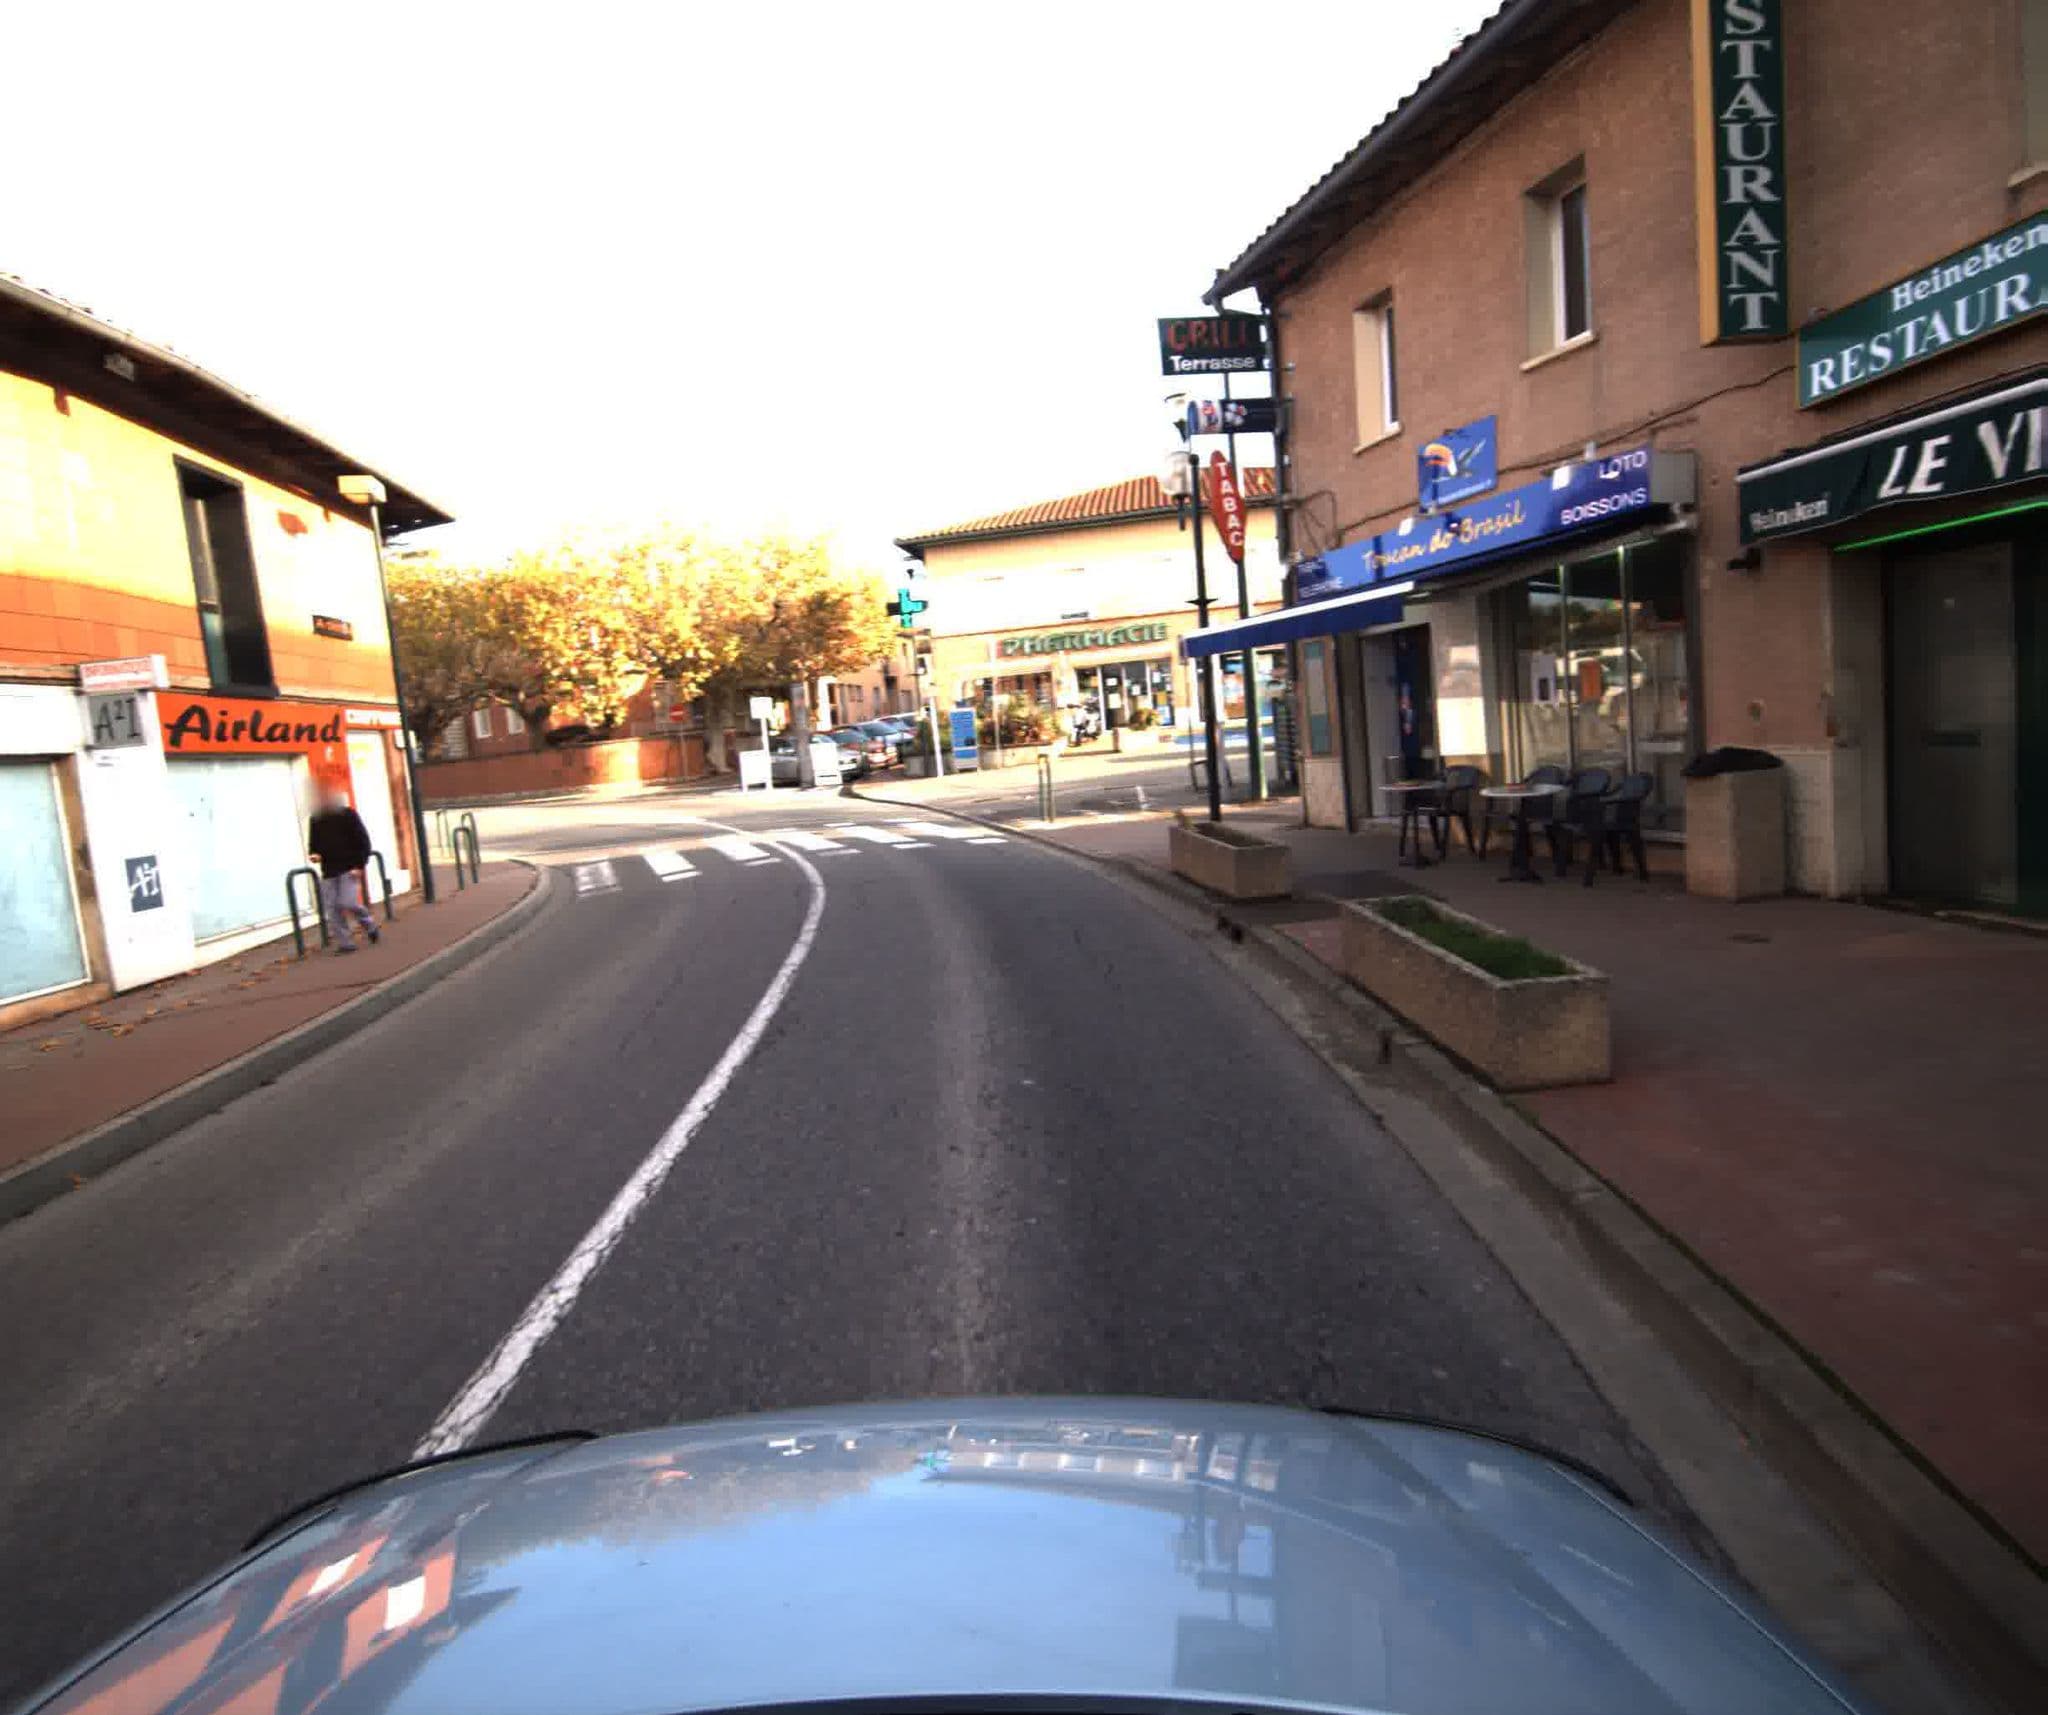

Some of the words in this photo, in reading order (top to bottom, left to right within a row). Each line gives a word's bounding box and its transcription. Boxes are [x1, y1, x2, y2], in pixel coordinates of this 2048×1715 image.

[1891, 222, 2048, 312] Heineken
[1169, 355, 1256, 372] Terrasse
[1599, 450, 1648, 479] LOTO
[1877, 434, 1952, 500] LE
[1215, 461, 1245, 547] TABAC
[1560, 486, 1648, 526] BOISSONS
[1001, 622, 1167, 656] PHARMACIE
[164, 704, 341, 748] Airland
